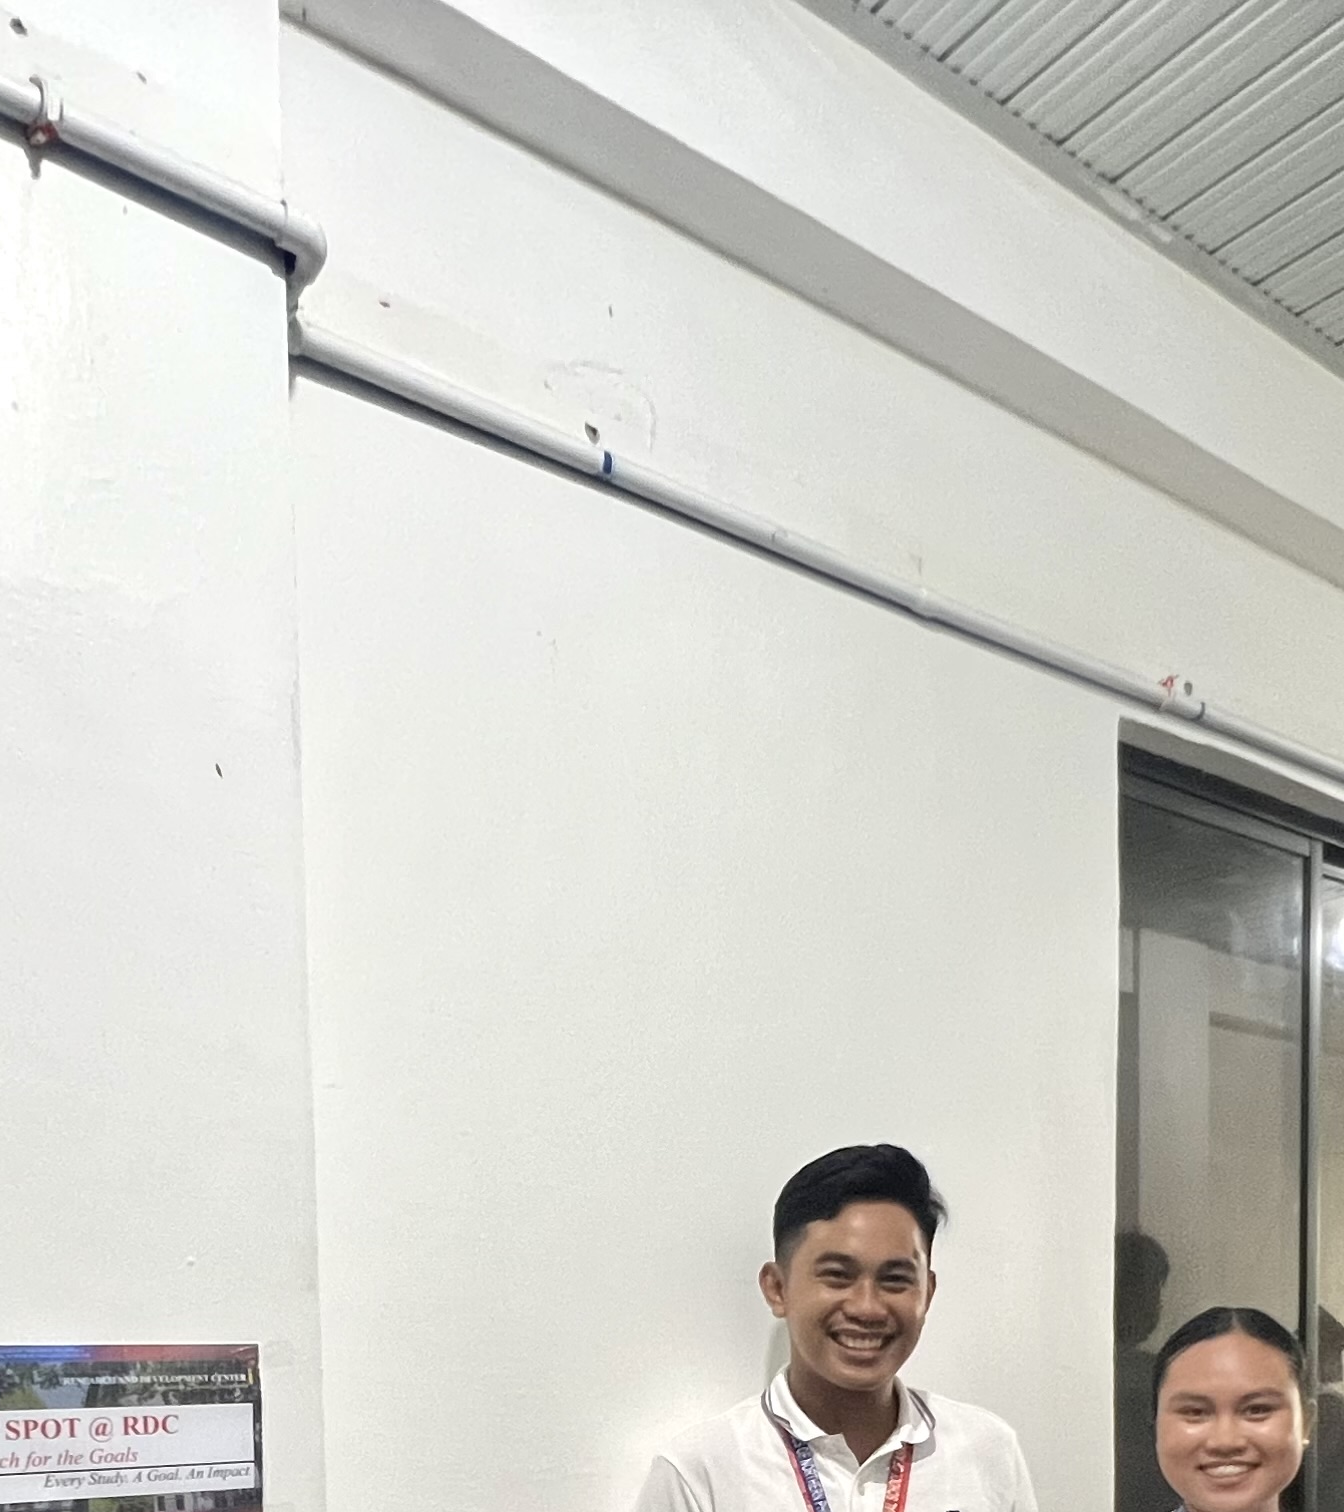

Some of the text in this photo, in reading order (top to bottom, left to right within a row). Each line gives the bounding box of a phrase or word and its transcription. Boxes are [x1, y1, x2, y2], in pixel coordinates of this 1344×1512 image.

[210, 1372, 247, 1383] CENTER
[5, 1417, 81, 1441] SPOT
[88, 1416, 114, 1443] @
[122, 1414, 179, 1436] RDC
[24, 1451, 52, 1472] for
[57, 1449, 84, 1466] the
[89, 1446, 139, 1465] Goals
[44, 1474, 86, 1491] Every
[132, 1470, 143, 1483] A
[185, 1467, 204, 1480] An
[207, 1465, 251, 1481] Impact
